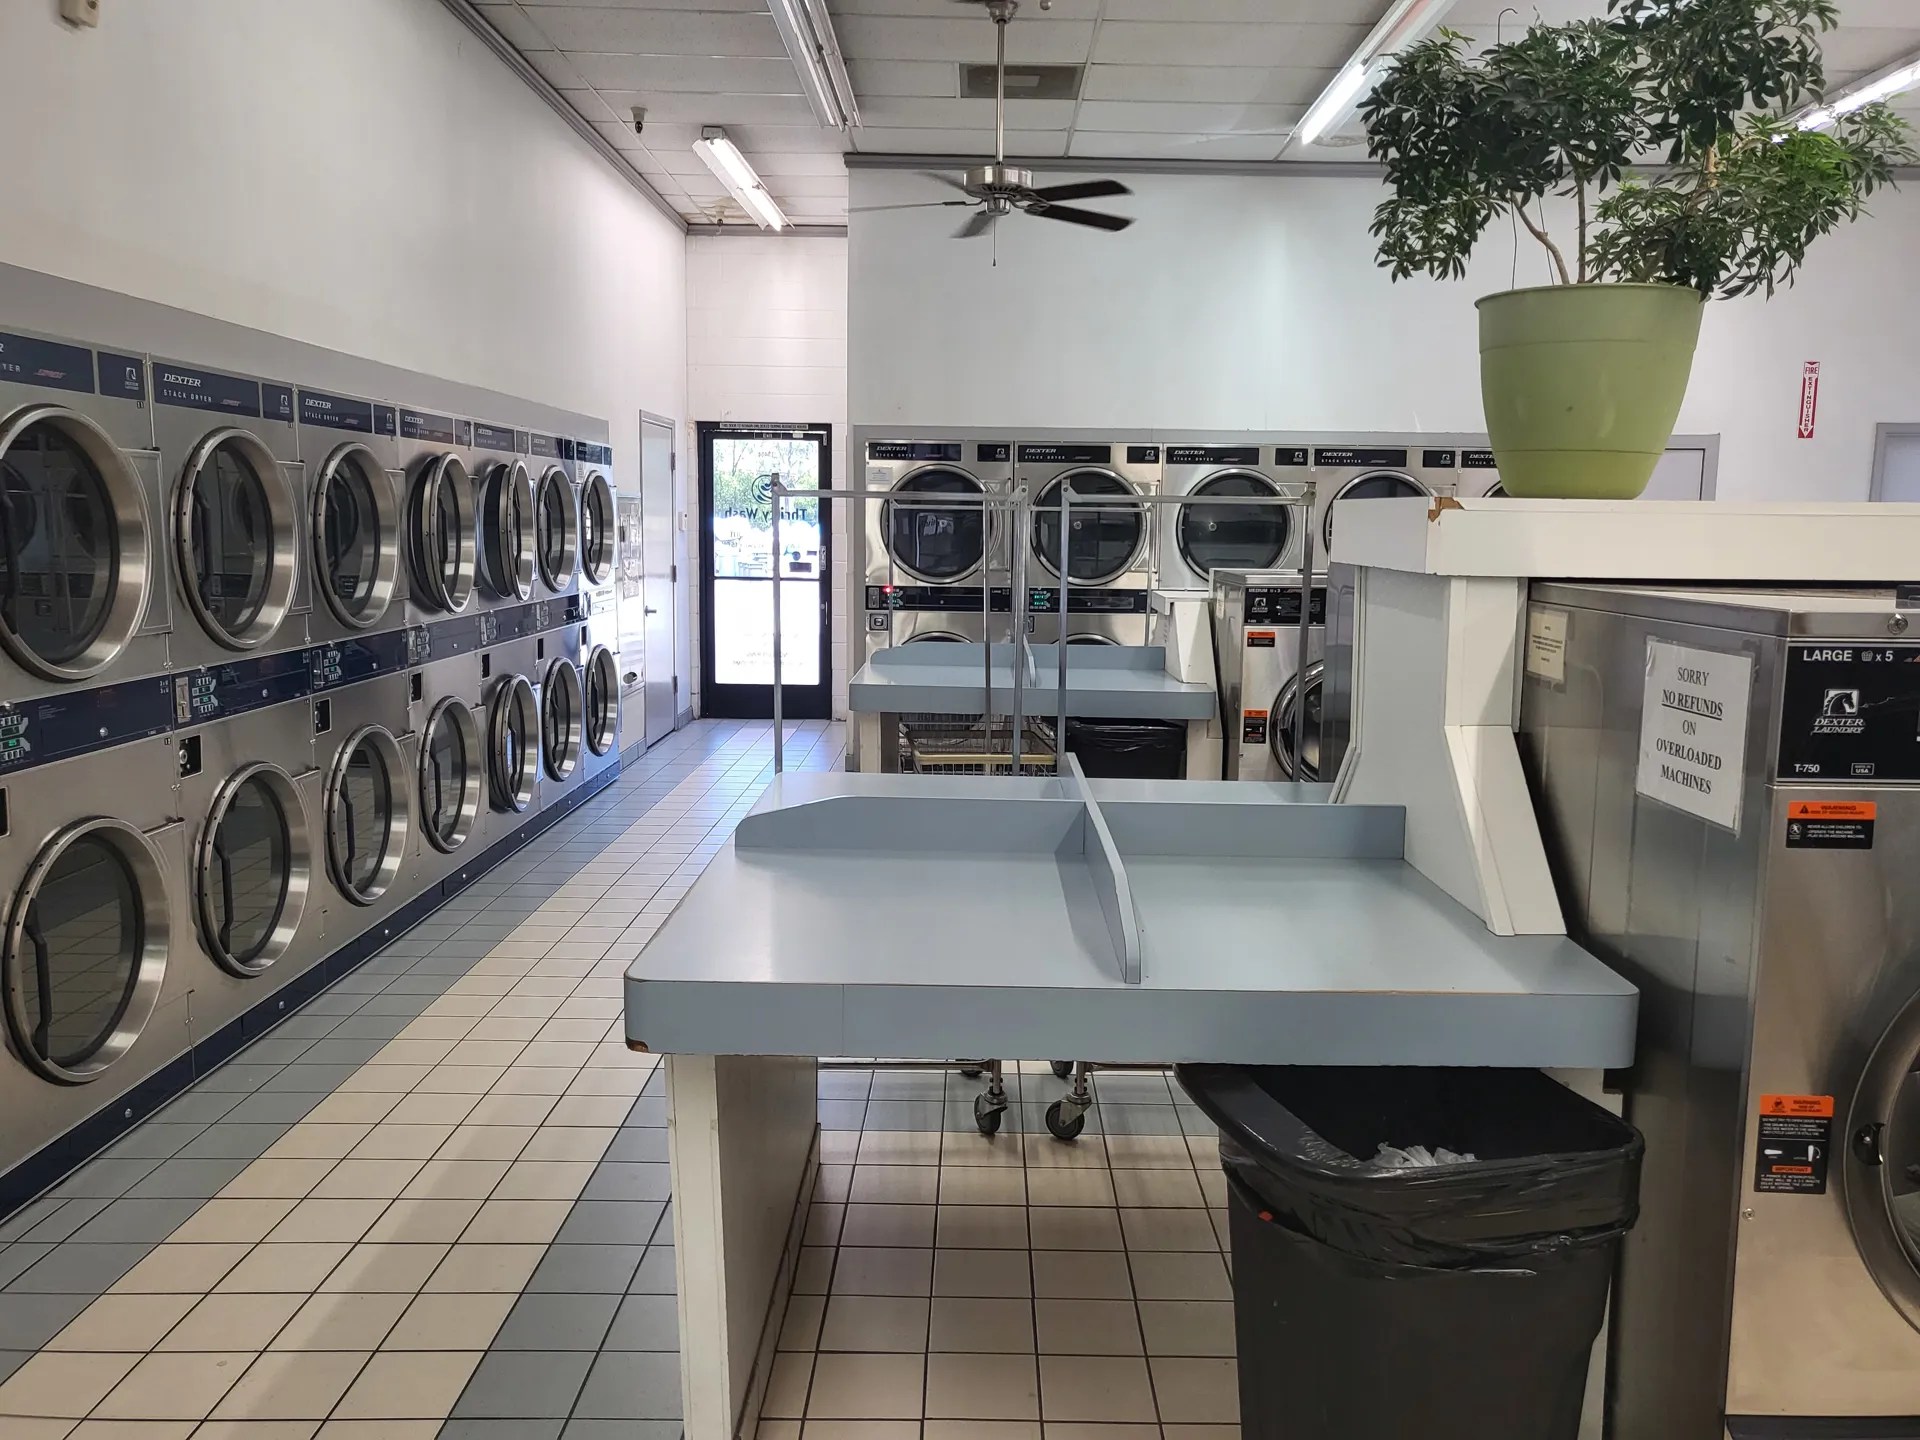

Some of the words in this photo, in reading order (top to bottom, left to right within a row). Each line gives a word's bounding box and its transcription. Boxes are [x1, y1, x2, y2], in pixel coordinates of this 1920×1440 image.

[1805, 366, 1819, 375] FIRE
[163, 373, 201, 387] DEXTER
[163, 389, 187, 399] STACK
[190, 393, 212, 403] DRYER
[305, 398, 332, 409] DEXTER
[1803, 376, 1813, 432] EXTINGUISHER
[404, 415, 424, 425] DEXTER
[1803, 650, 1852, 661] LARGE
[1884, 651, 1894, 661] 5
[1677, 667, 1709, 686] SORRY
[1662, 689, 1676, 704] NO
[1677, 692, 1723, 717] REFUNDS
[1682, 720, 1696, 736] ON
[1813, 718, 1864, 726] DEXTER
[1812, 726, 1865, 735] LAUNDRY
[1656, 738, 1722, 771] OVERLOADED
[1794, 764, 1820, 773] T-750
[1660, 764, 1712, 795] MACHINES
